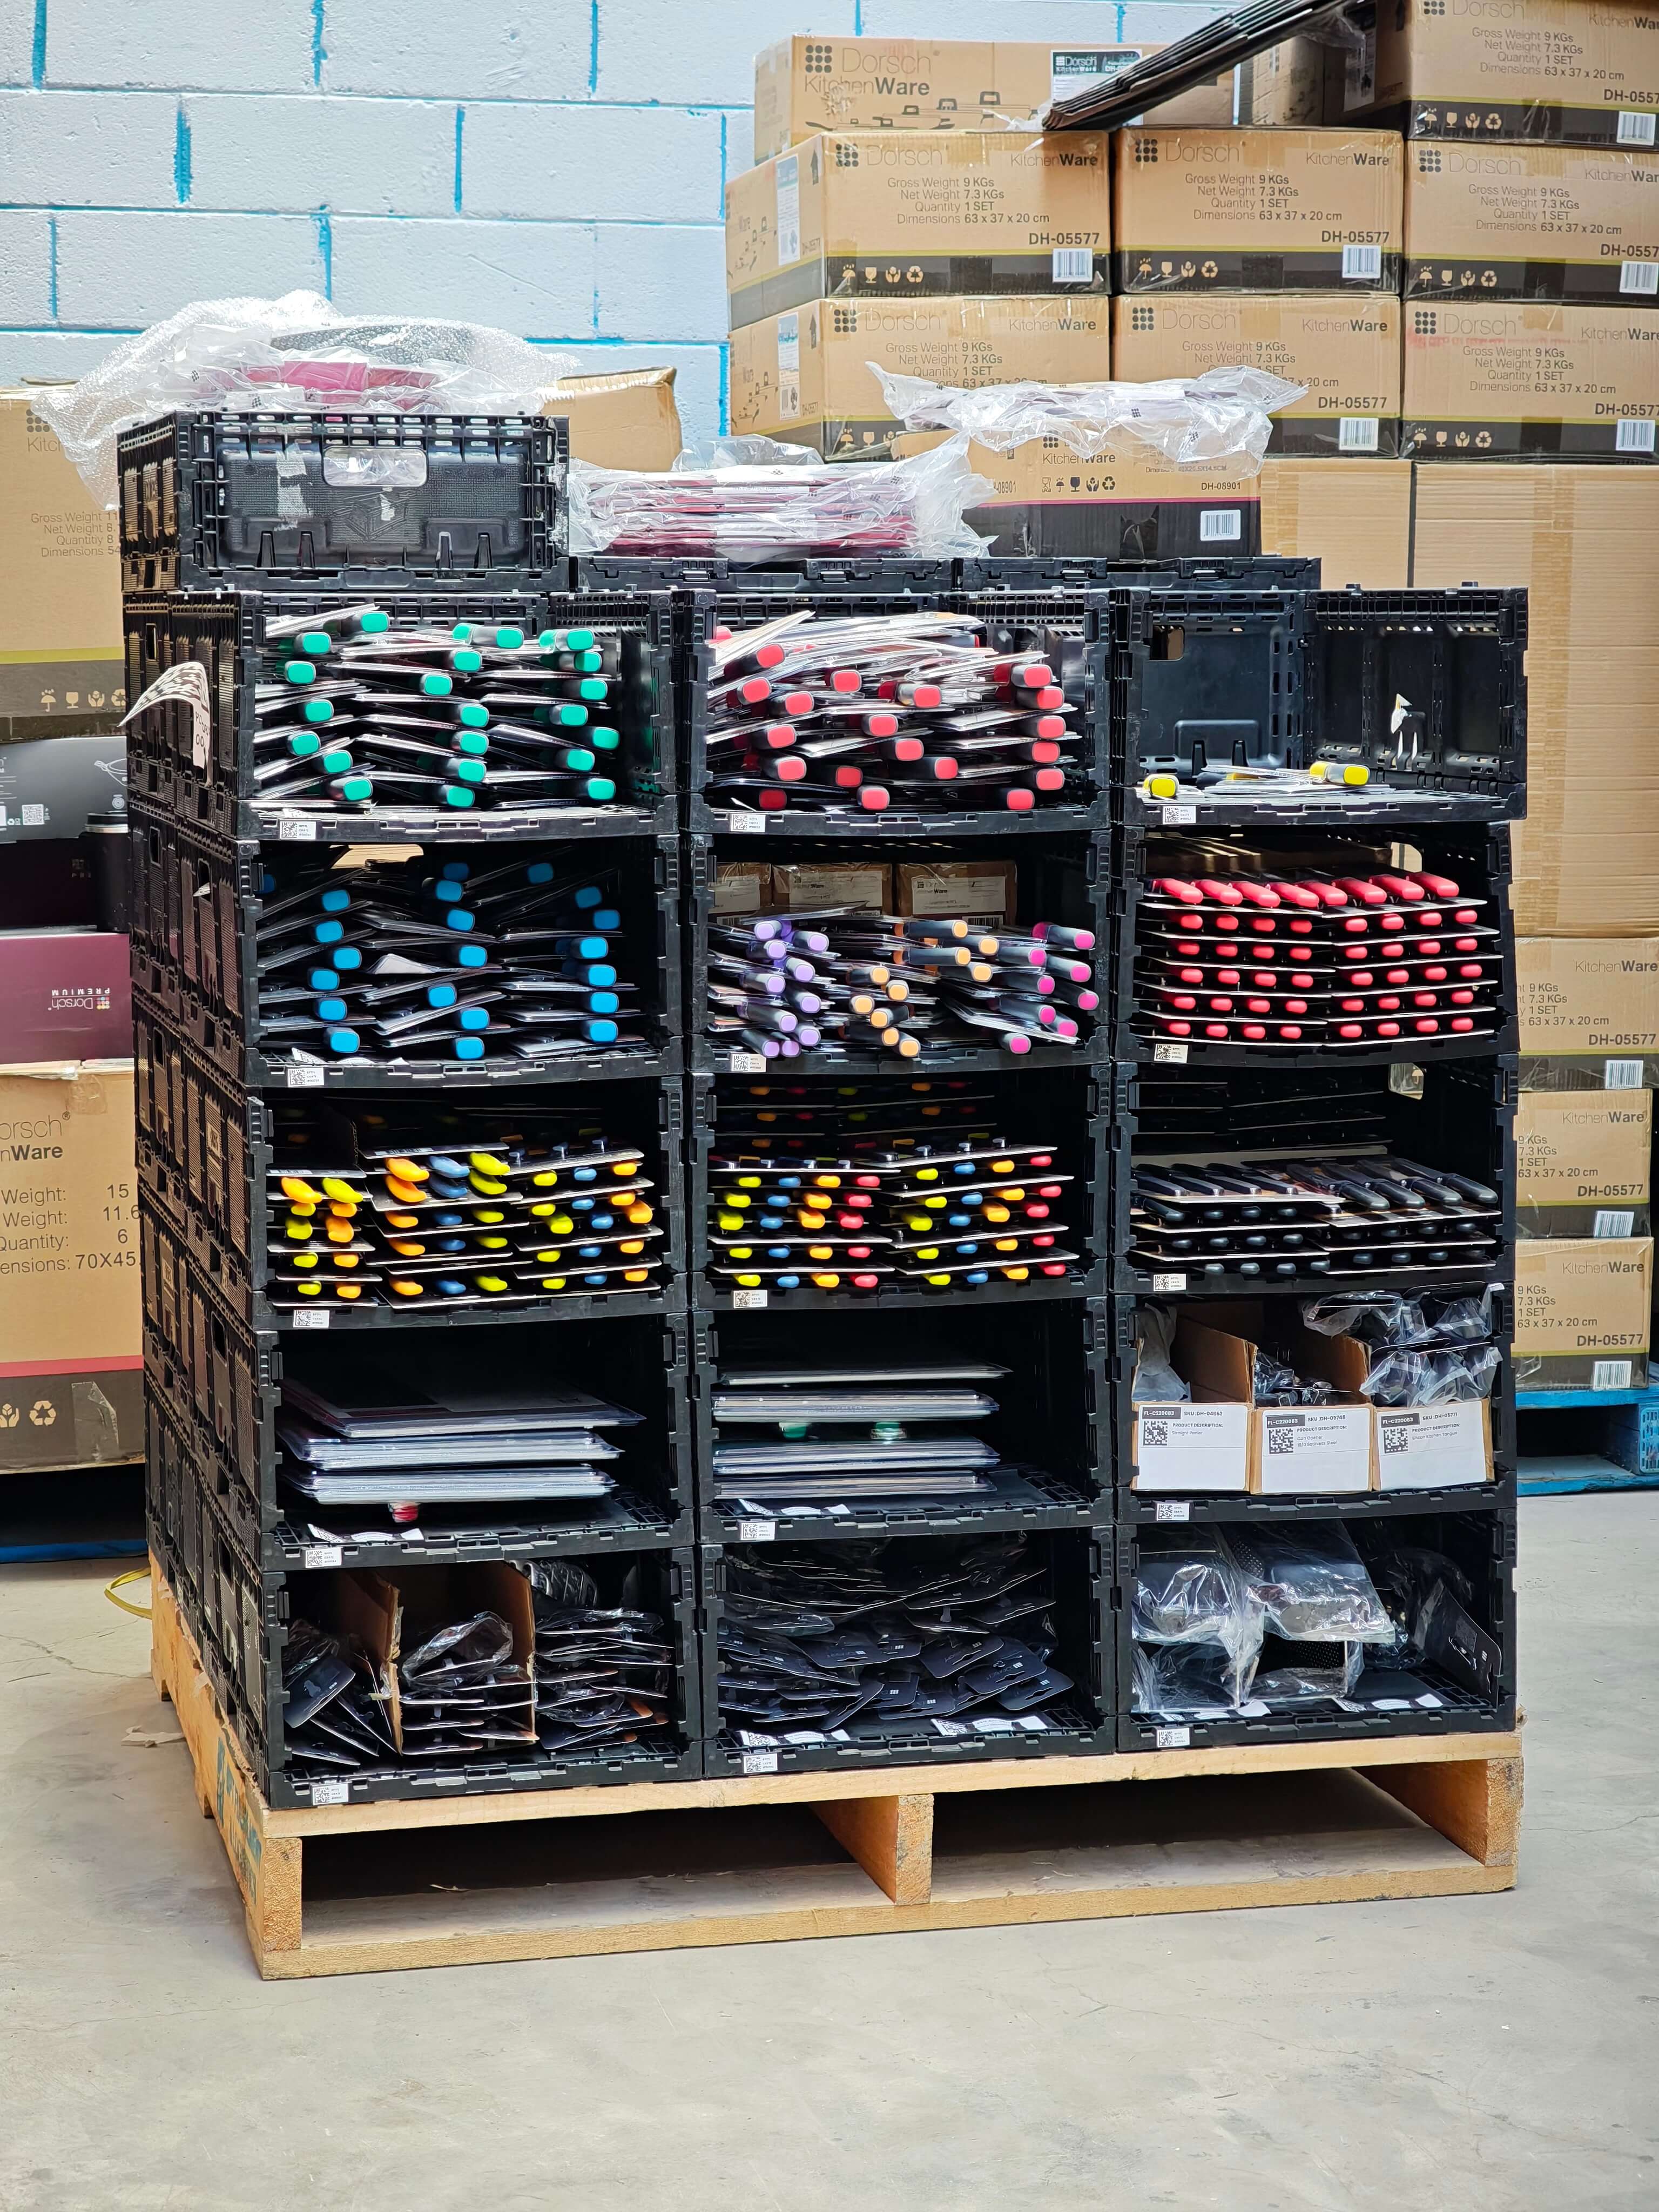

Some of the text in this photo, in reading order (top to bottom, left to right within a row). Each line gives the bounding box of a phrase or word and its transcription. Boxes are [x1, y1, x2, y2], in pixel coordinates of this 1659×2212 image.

[841, 47, 931, 74] Dorsch
[867, 144, 942, 166] Dorsch
[1166, 140, 1240, 163] Dorsch
[1011, 152, 1098, 167] KitchenWare
[1306, 152, 1390, 166] KitchenWare
[1449, 152, 1521, 175] Dorsch
[888, 177, 994, 190] Gross Weight 9 KGs
[1185, 173, 1290, 187] Gross Weight 9 KGs
[901, 189, 1004, 201] Net Weight 7.3 KGs
[1198, 186, 1299, 199] Net Weight 7.3 KGs
[915, 201, 994, 213] Quantity 1 SET
[1211, 198, 1289, 210] Quantity 1 SET
[898, 213, 961, 225] Dimensions
[964, 213, 978, 223] 63
[990, 213, 1004, 223] 37
[1015, 213, 1030, 223] 20
[1193, 209, 1256, 220] Dimensions
[1259, 210, 1273, 220] 63
[1284, 211, 1298, 220] 37
[1310, 211, 1324, 221] 20
[1326, 213, 1342, 221] cm
[1029, 233, 1100, 245] DH-05577
[1321, 231, 1390, 243] DH-05577
[865, 309, 940, 331] Dorsch
[1009, 318, 1096, 331] KitchenWare
[1163, 309, 1236, 330] Dorsch
[1303, 318, 1388, 332] KitchenWare
[1444, 313, 1516, 335] Dorsch
[1463, 346, 1564, 359] Gross Weight 9 KGs
[1475, 358, 1574, 370] Net Weight 7.3 KGs
[1488, 370, 1564, 382] Quantity 1 SET
[1470, 381, 1530, 393] Dimensions
[1534, 383, 1548, 393] 63
[1560, 384, 1572, 393] 37
[1584, 385, 1597, 394] 20
[1318, 396, 1387, 409] DH-05577
[1201, 482, 1241, 490] DH-08901
[31, 512, 103, 524] Gross Weight
[44, 524, 103, 536] Net Weight
[41, 547, 104, 557] Dimensions
[1575, 960, 1658, 973] KitchenWare
[51, 987, 110, 996] PREMIUM
[1529, 983, 1559, 992] 9 KGs
[51, 997, 93, 1010] Dorsch
[1529, 995, 1567, 1003] 7.3 KGs
[1529, 1006, 1557, 1014] 1 SET
[1529, 1017, 1541, 1026] 63
[1554, 1017, 1566, 1025] 37
[1578, 1016, 1590, 1025] 20
[1589, 1034, 1656, 1046] DH-05577
[1562, 1111, 1644, 1124] KitchenWare
[1519, 1135, 1547, 1144] 9 KGs
[1519, 1147, 1557, 1156] 7.3 KGs
[1519, 1157, 1548, 1166] 1 SET
[1518, 1169, 1530, 1177] 63
[1542, 1169, 1555, 1177] 37
[1567, 1168, 1580, 1177] 20
[1583, 1169, 1598, 1177] cm
[1, 1184, 129, 1206] Weight: 15
[1577, 1184, 1643, 1197] DH-05577
[3, 1210, 68, 1229] Weight:
[117, 1229, 128, 1244] 6
[1562, 1261, 1644, 1274] KitchenWare
[1518, 1285, 1547, 1294] 9 KGs
[1518, 1297, 1556, 1305] 7.3 KGs
[1518, 1307, 1546, 1317] 1 SET
[1518, 1319, 1530, 1328] 63
[1542, 1319, 1554, 1327] 37
[1566, 1318, 1579, 1326] 20
[1582, 1318, 1597, 1326] cm
[1577, 1334, 1643, 1346] DH-05577
